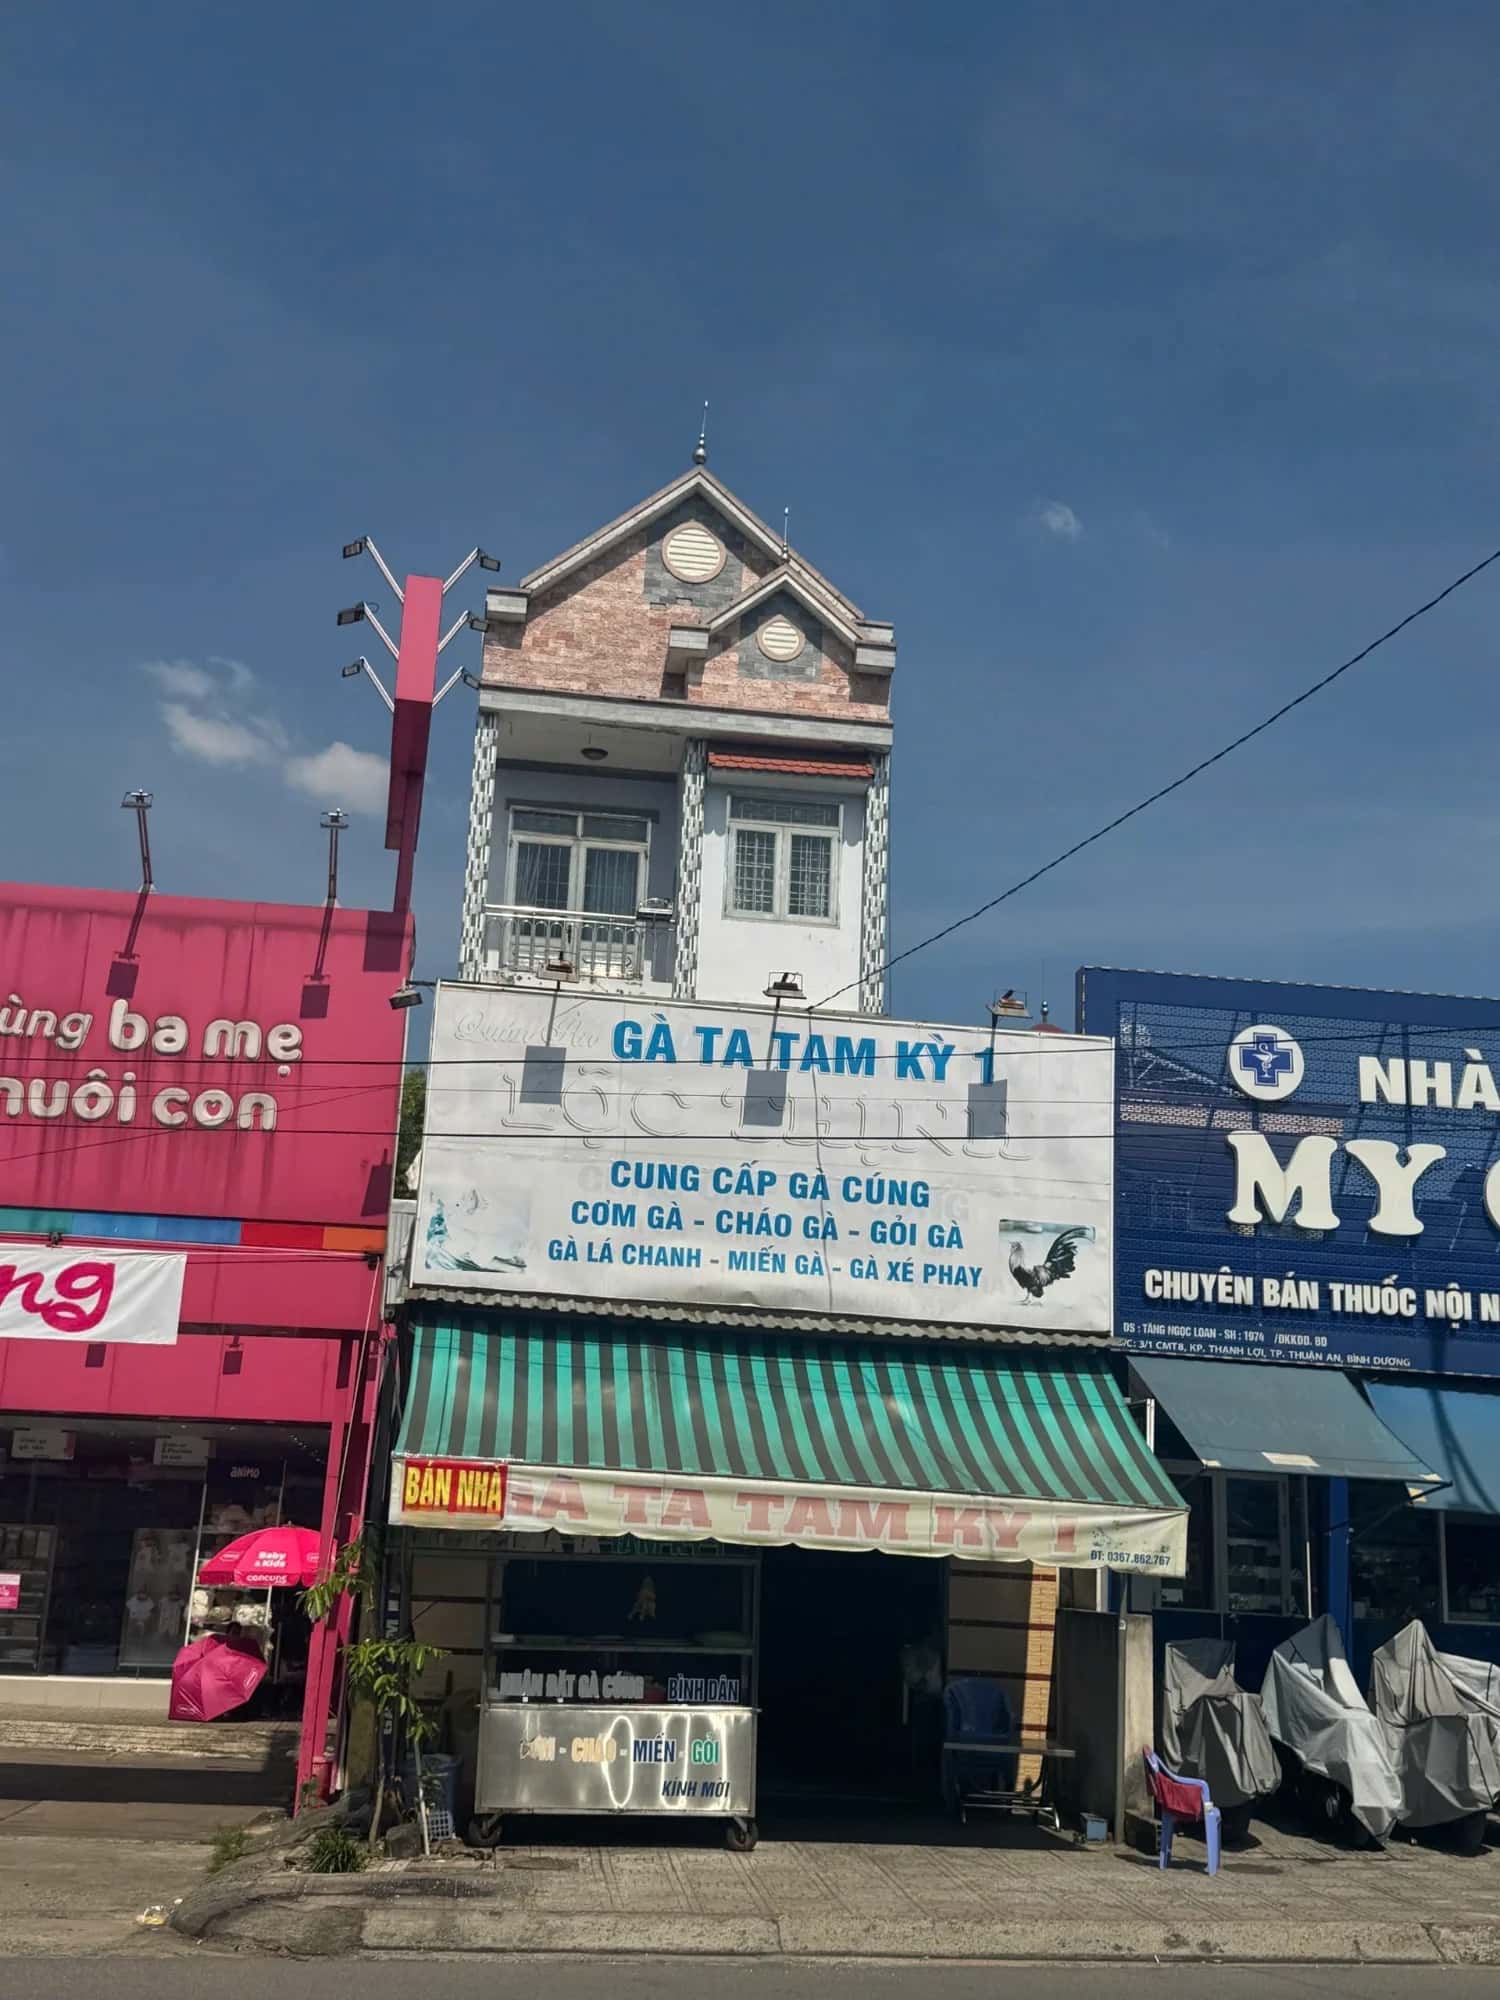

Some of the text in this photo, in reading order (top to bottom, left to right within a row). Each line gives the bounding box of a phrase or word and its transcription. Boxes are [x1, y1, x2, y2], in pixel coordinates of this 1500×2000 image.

[109, 998, 189, 1054] ba
[203, 1018, 303, 1077] mẹ
[612, 1012, 677, 1064] GÀ
[694, 1026, 755, 1067] TA
[772, 1032, 876, 1077] TAM
[896, 1033, 955, 1082] KỲ
[1359, 1048, 1500, 1112] NHÀ
[152, 1086, 278, 1131] con
[611, 1160, 930, 1208] CUNG CẤP GÀ CÚNG
[1225, 1130, 1447, 1236] MY
[571, 1200, 637, 1228] CƠM
[647, 1201, 683, 1231] GÀ
[716, 1207, 792, 1238] CHÁO
[803, 1211, 838, 1241] GÀ
[870, 1214, 917, 1246] GỎI
[928, 1219, 964, 1249] GÀ
[548, 1234, 578, 1261] GÀ
[587, 1237, 613, 1264] LÁ
[622, 1243, 702, 1268] CHANH
[728, 1245, 786, 1273] MIẾN
[795, 1250, 824, 1276] GÀ
[850, 1254, 879, 1280] GÀ
[887, 1257, 914, 1283] XÉ
[923, 1263, 983, 1288] PHAY
[1145, 1266, 1254, 1306] CHUYÊN
[1262, 1271, 1319, 1310] BÁN
[1328, 1274, 1417, 1317] THUỐC
[1425, 1282, 1472, 1328] NỘI
[1139, 1340, 1153, 1349] 3/1
[1208, 1345, 1245, 1355] THANH
[1193, 1328, 1217, 1338] LOAN
[405, 1462, 452, 1506] BÁN
[612, 1484, 712, 1528] TA
[736, 1492, 910, 1541] TAM
[633, 1732, 676, 1763] MIẾN
[662, 1777, 698, 1797] KÍNH
